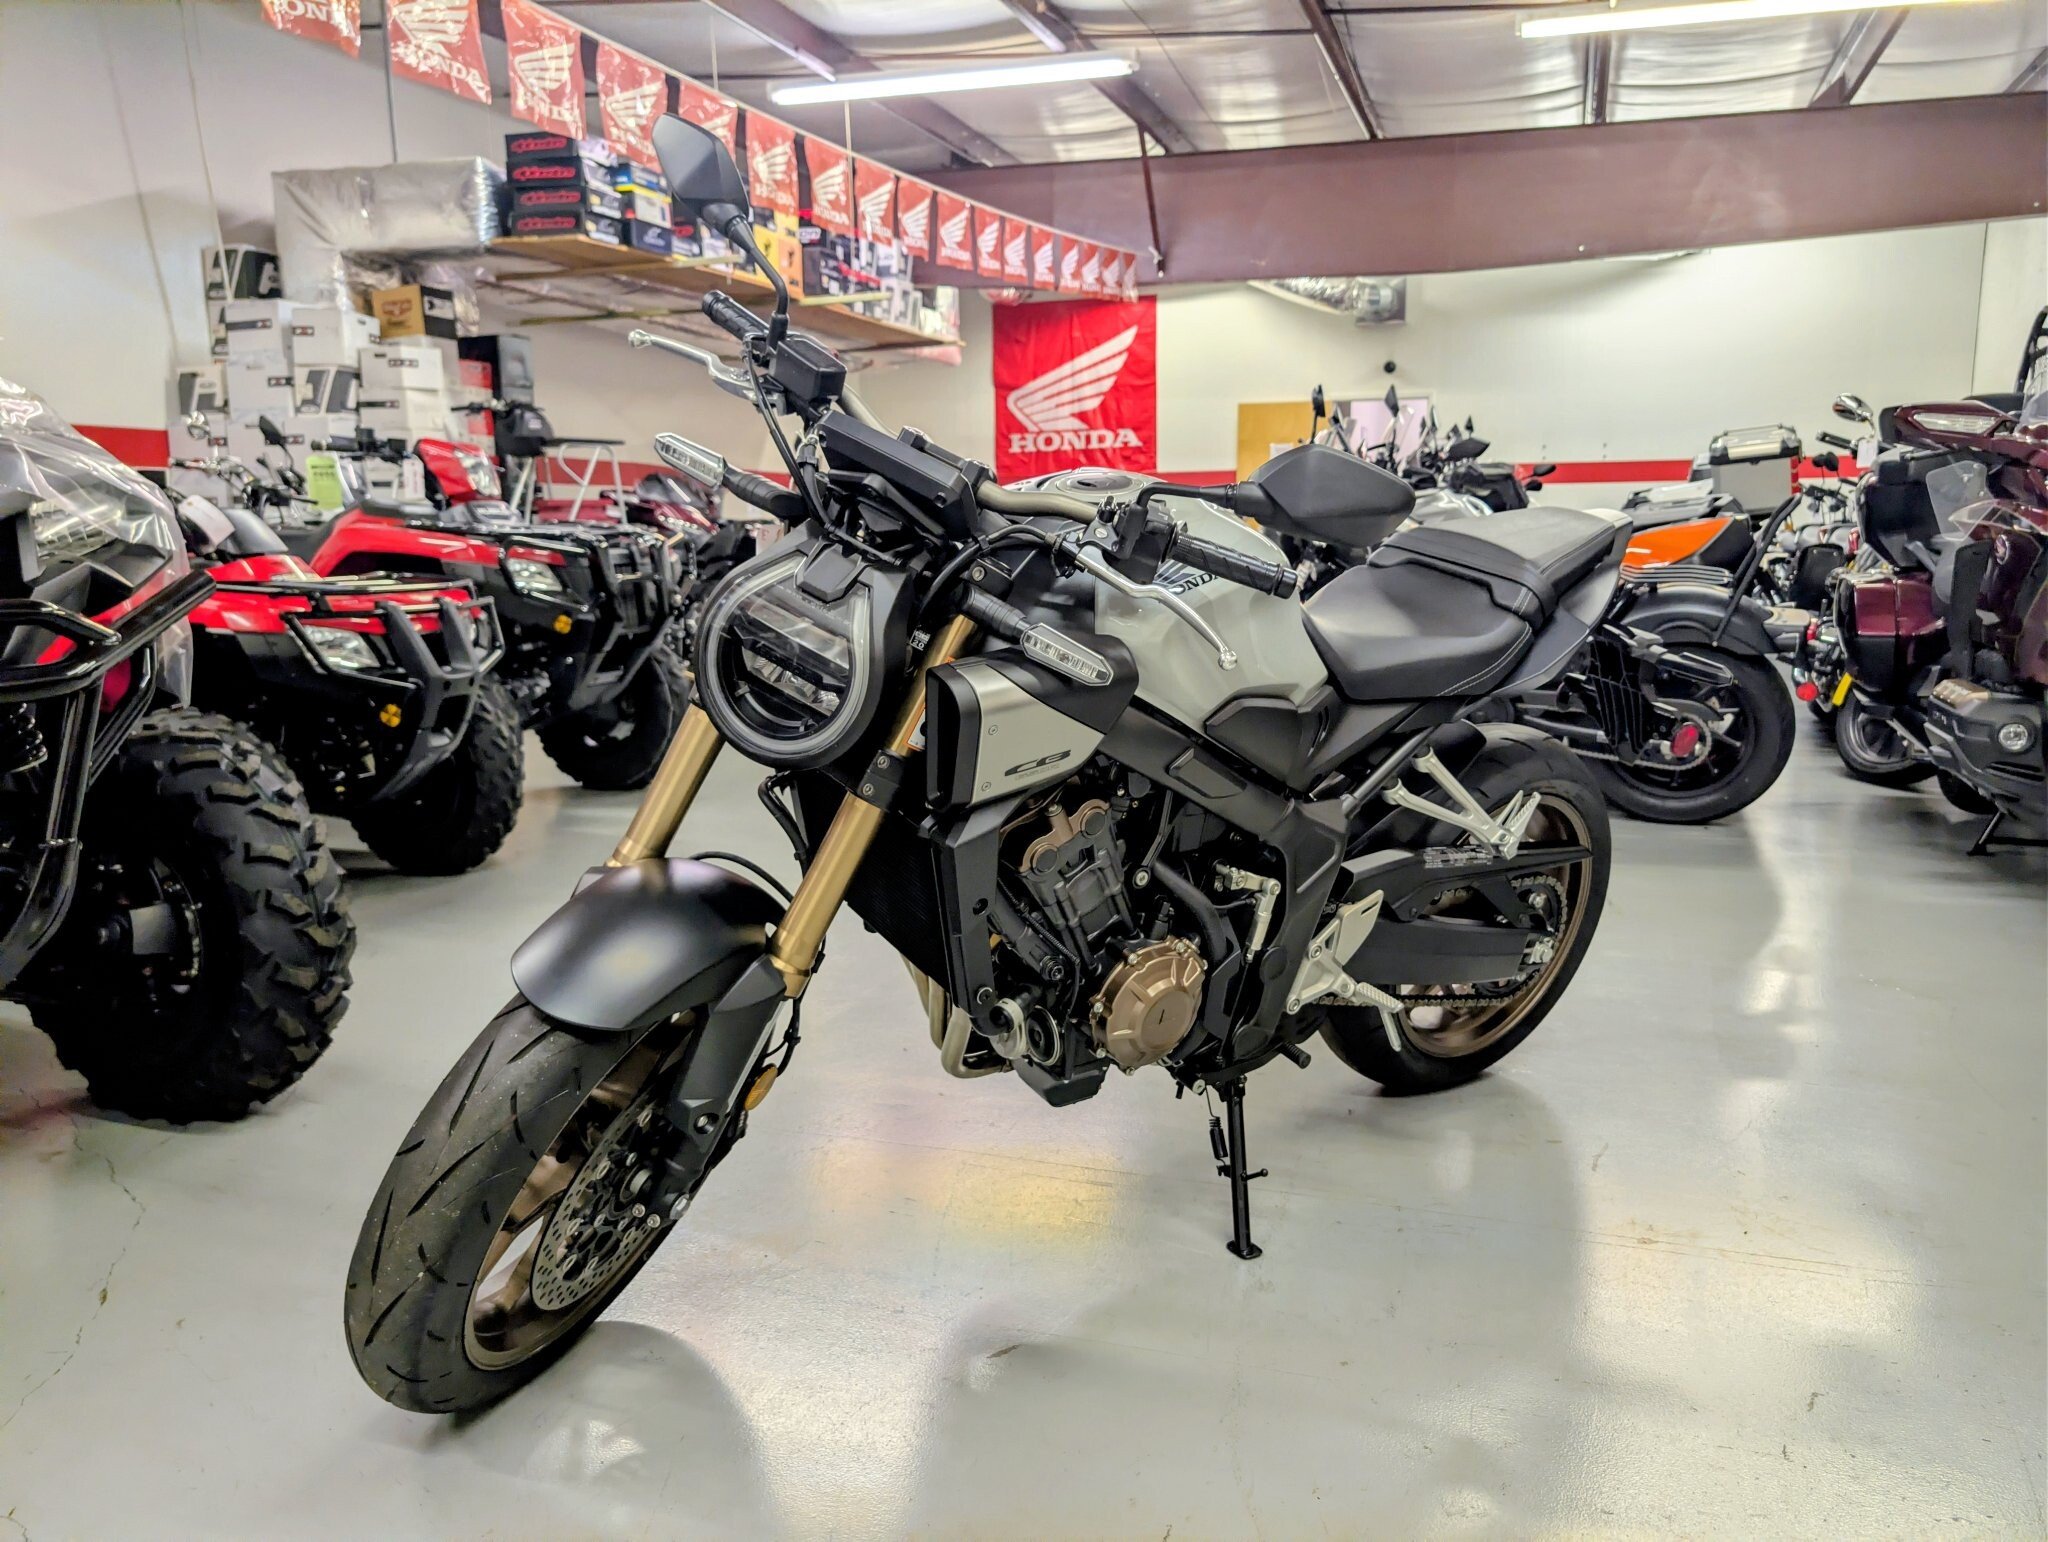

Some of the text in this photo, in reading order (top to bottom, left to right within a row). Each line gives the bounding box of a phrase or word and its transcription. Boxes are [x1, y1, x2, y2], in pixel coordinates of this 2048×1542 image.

[1008, 428, 1143, 454] HONDA
[1168, 572, 1218, 596] OND
[1004, 749, 1071, 777] CB
